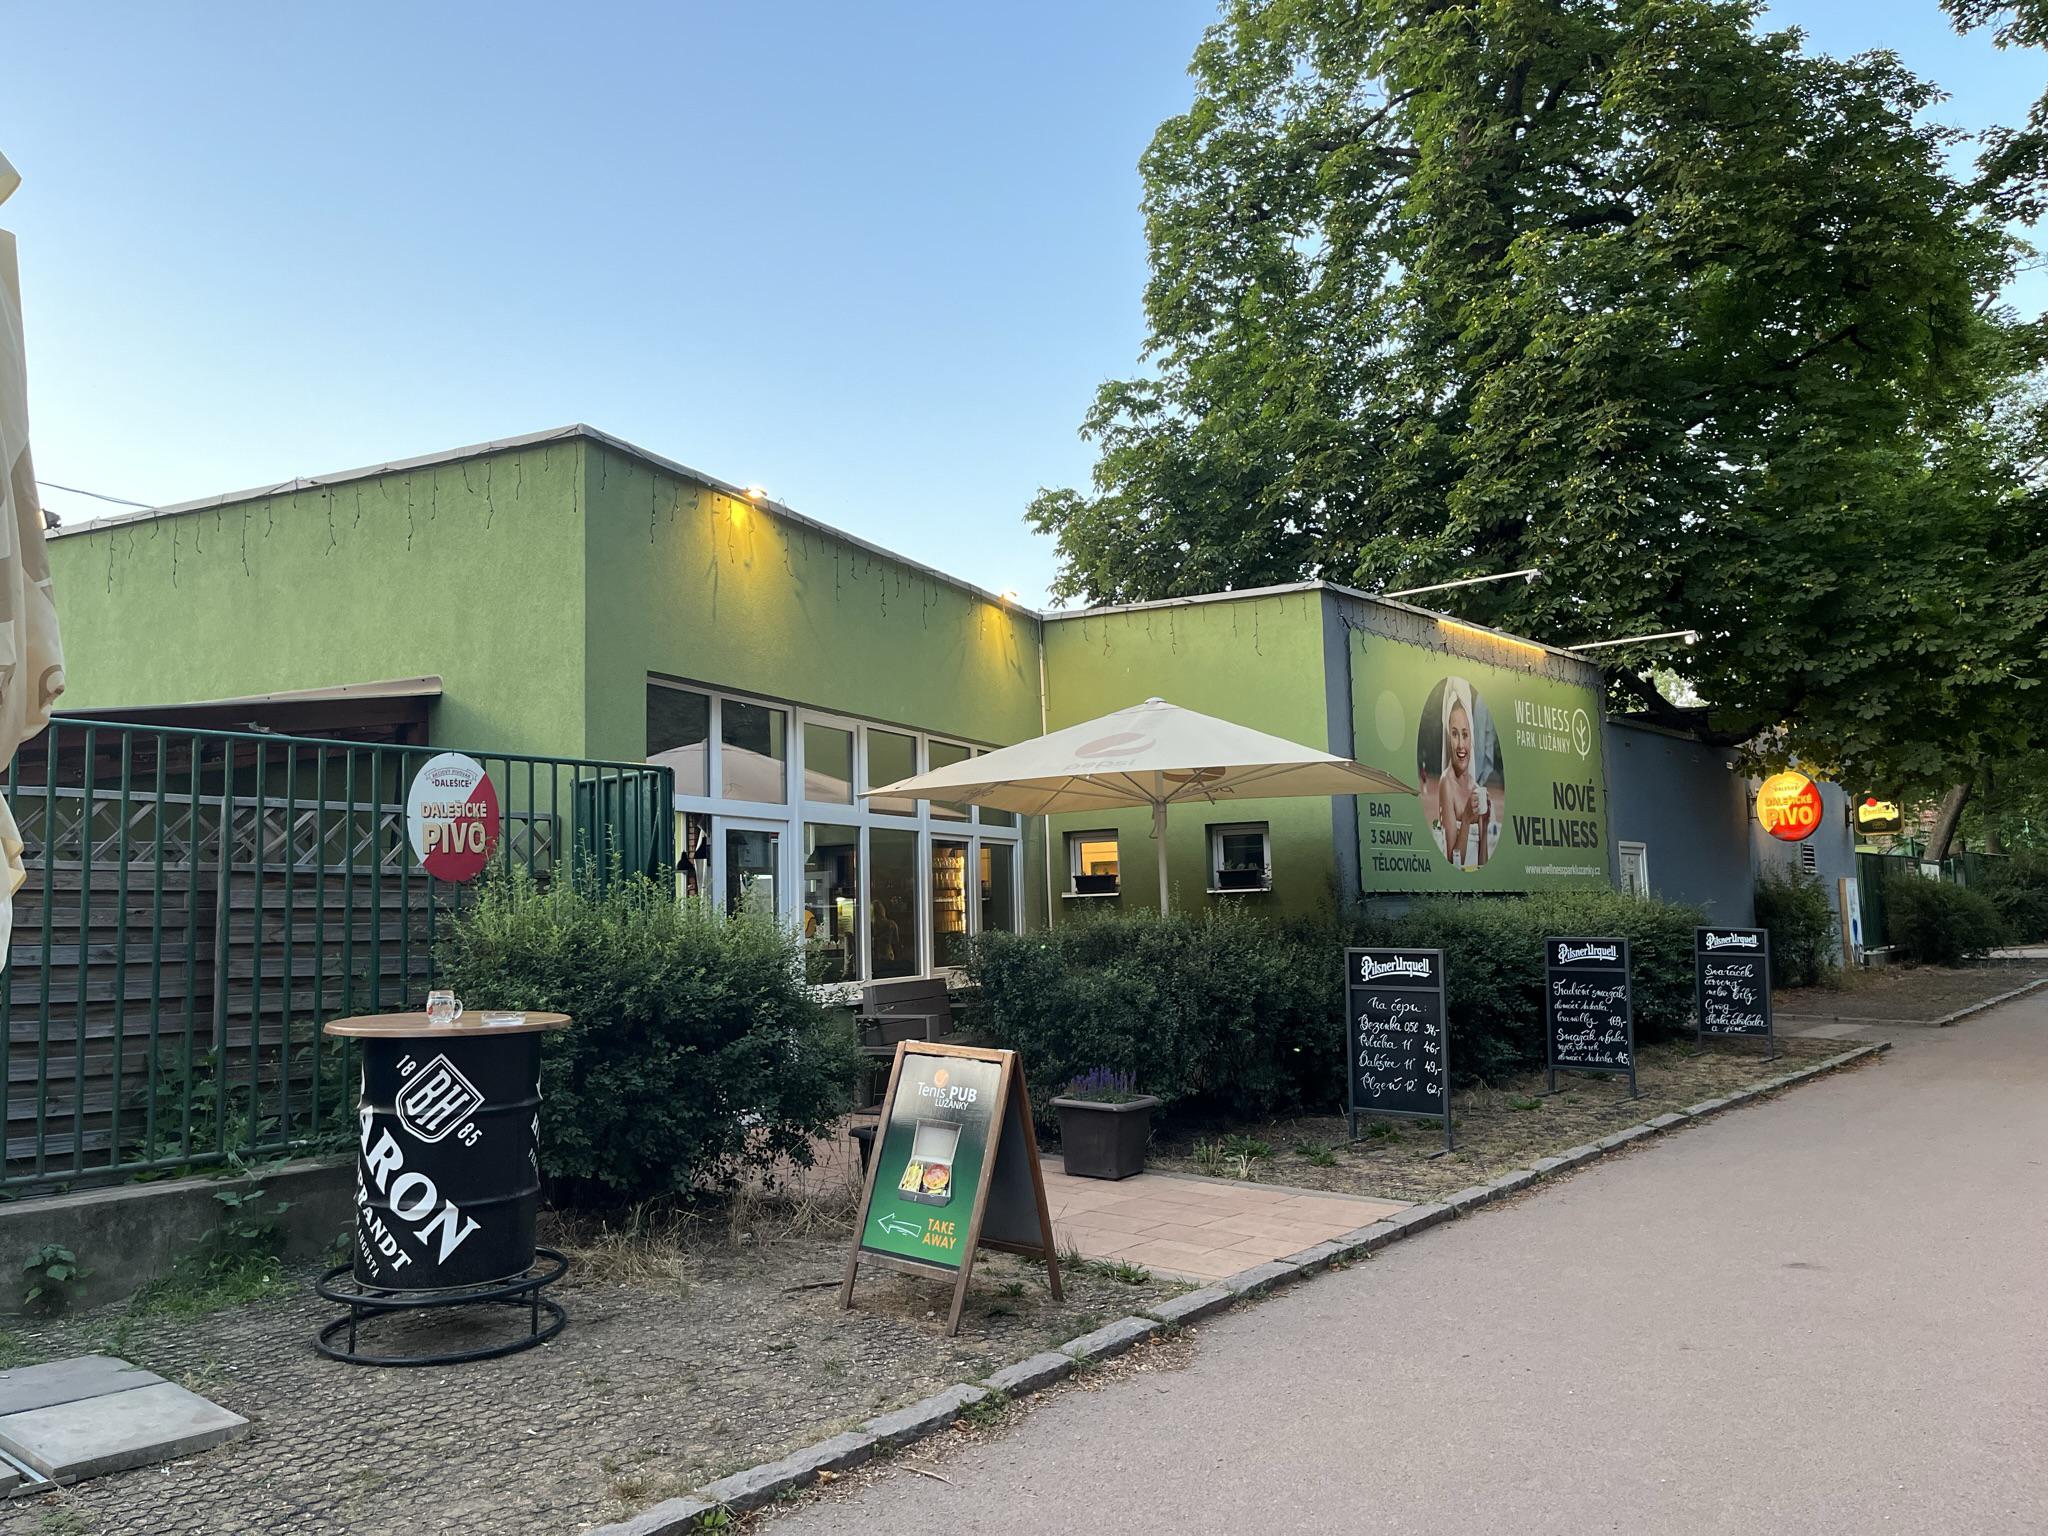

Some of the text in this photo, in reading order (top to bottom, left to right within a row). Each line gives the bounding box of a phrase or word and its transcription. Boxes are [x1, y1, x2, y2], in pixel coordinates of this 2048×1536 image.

[1514, 699, 1570, 733] WELLNESS
[1516, 729, 1571, 754] PARK LUŽÁNKY
[434, 778, 470, 788] DALEŠICE
[1553, 778, 1597, 813] NOVÉ
[421, 800, 487, 818] DALEŠICKÉ
[1369, 802, 1391, 818] BAR
[1765, 805, 1814, 827] PIVO
[422, 821, 486, 855] PIVO
[1371, 830, 1413, 846] 3 SAUNY
[1513, 815, 1599, 849] WELLNESS
[1372, 853, 1432, 873] TĚLOCVIČNA
[1705, 932, 1732, 950] Pilsner
[1558, 943, 1588, 964] Pilsner
[1361, 955, 1396, 981] Pilsner
[1553, 979, 1593, 996] Tradiční
[1706, 986, 1728, 997] nebo
[1705, 999, 1738, 1014] Grog
[1358, 1014, 1402, 1034] Bezinka
[1556, 1028, 1597, 1046] Smažák
[397, 1054, 417, 1077] 18
[917, 1081, 978, 1103] Tenis PUB
[1360, 1072, 1402, 1098] Plzeň
[405, 1069, 471, 1131] BH
[457, 1122, 483, 1147] 85
[357, 1061, 481, 1266] ARON
[927, 1218, 955, 1235] TAKE
[921, 1233, 957, 1250] AWAY
